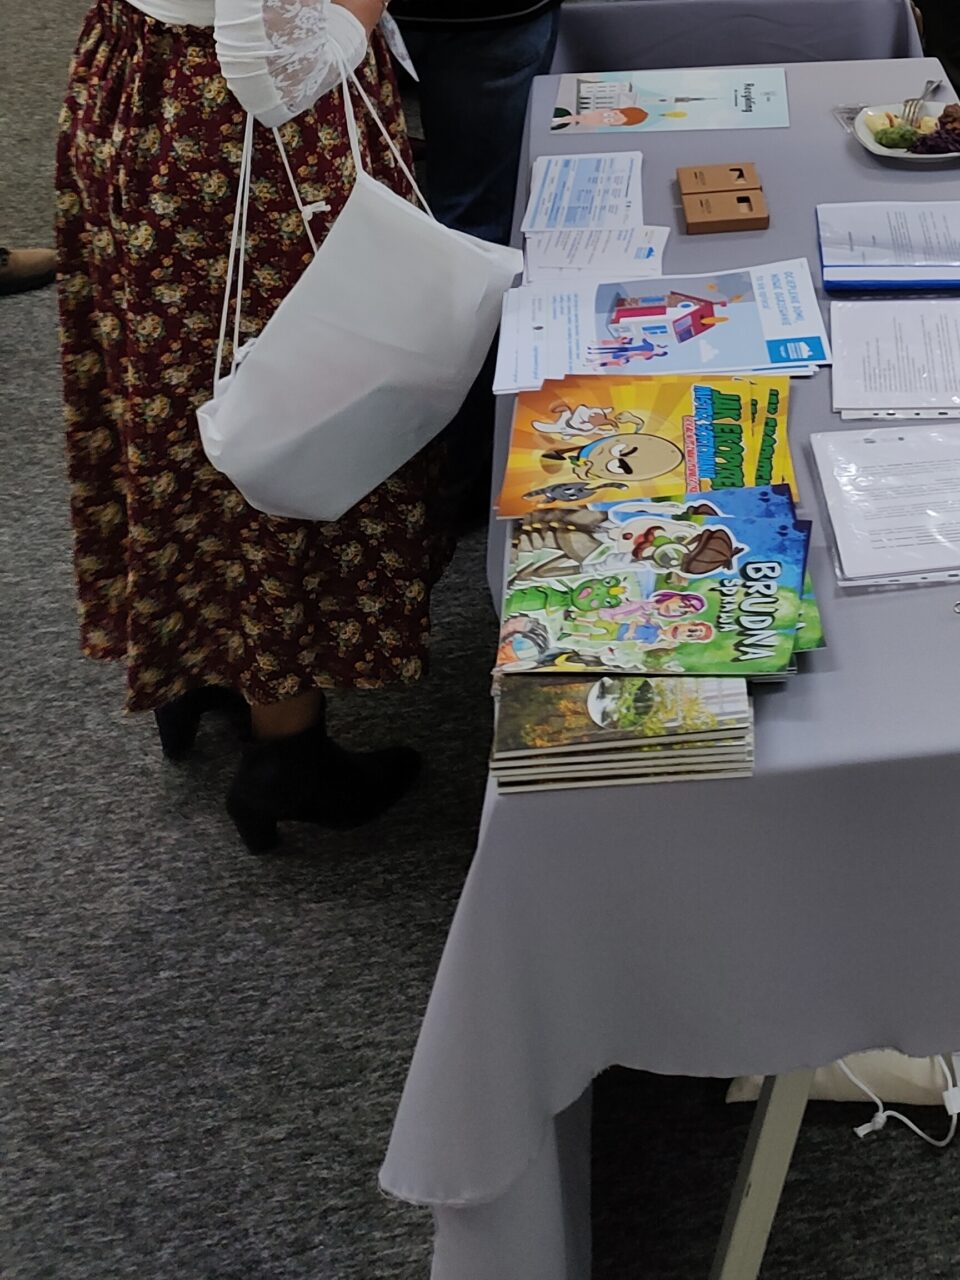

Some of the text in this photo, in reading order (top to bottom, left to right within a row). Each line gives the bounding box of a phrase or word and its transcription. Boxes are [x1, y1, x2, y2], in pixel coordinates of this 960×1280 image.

[711, 388, 745, 490] JAK EKOPYRE
[736, 561, 782, 662] BRUDNA
